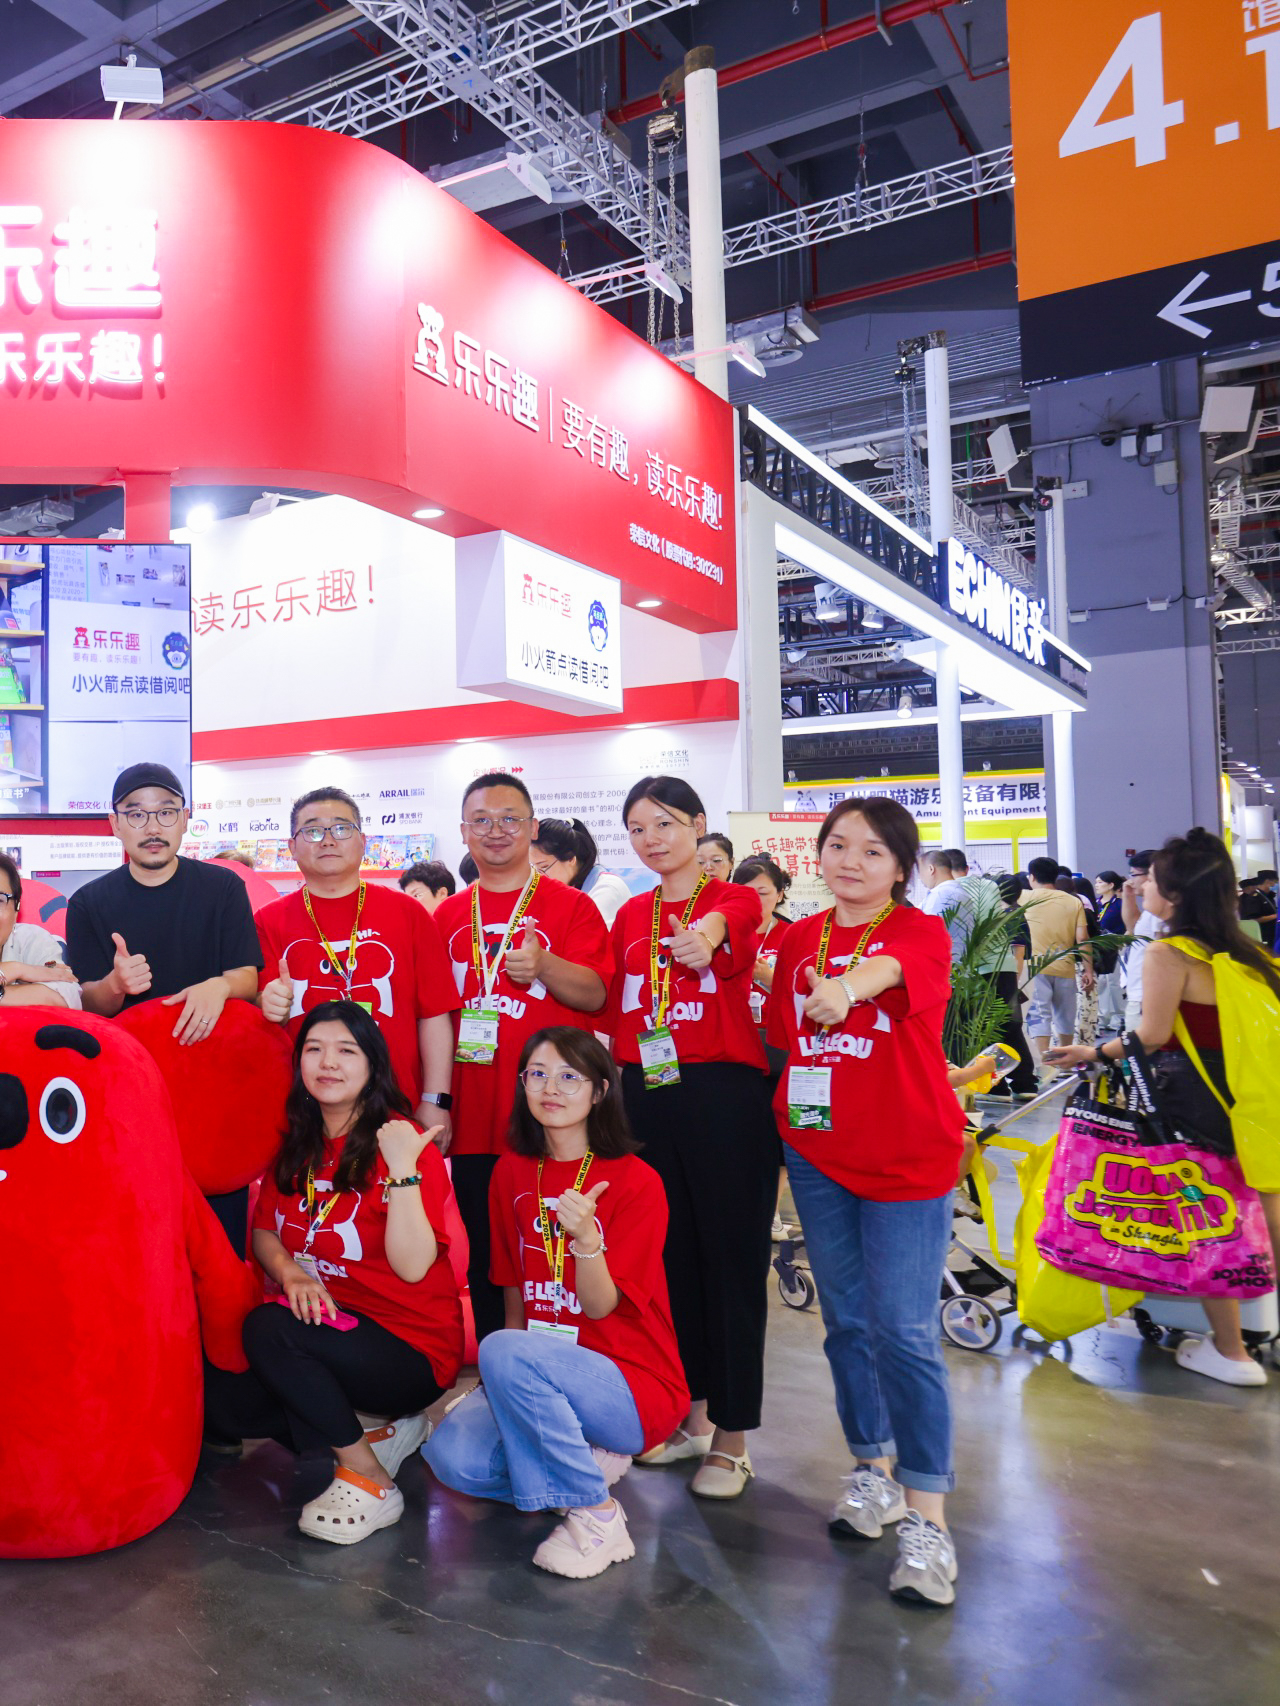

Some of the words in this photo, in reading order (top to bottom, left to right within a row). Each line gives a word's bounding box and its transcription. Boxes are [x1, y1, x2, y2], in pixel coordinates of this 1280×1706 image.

[453, 331, 540, 433] 乐乐趣
[94, 630, 141, 651] 乐乐趣
[521, 642, 610, 690] 小火箭点读借阅吧
[72, 673, 190, 694] 小火箭点读借阅吧
[379, 789, 410, 798] ARRAIL
[606, 790, 627, 798] 2006
[981, 805, 1040, 816] Equipment
[249, 821, 280, 832] kabrita
[681, 895, 697, 925] CHILDREN
[576, 1152, 593, 1187] CHILDREN
[542, 1223, 551, 1242] 2024
